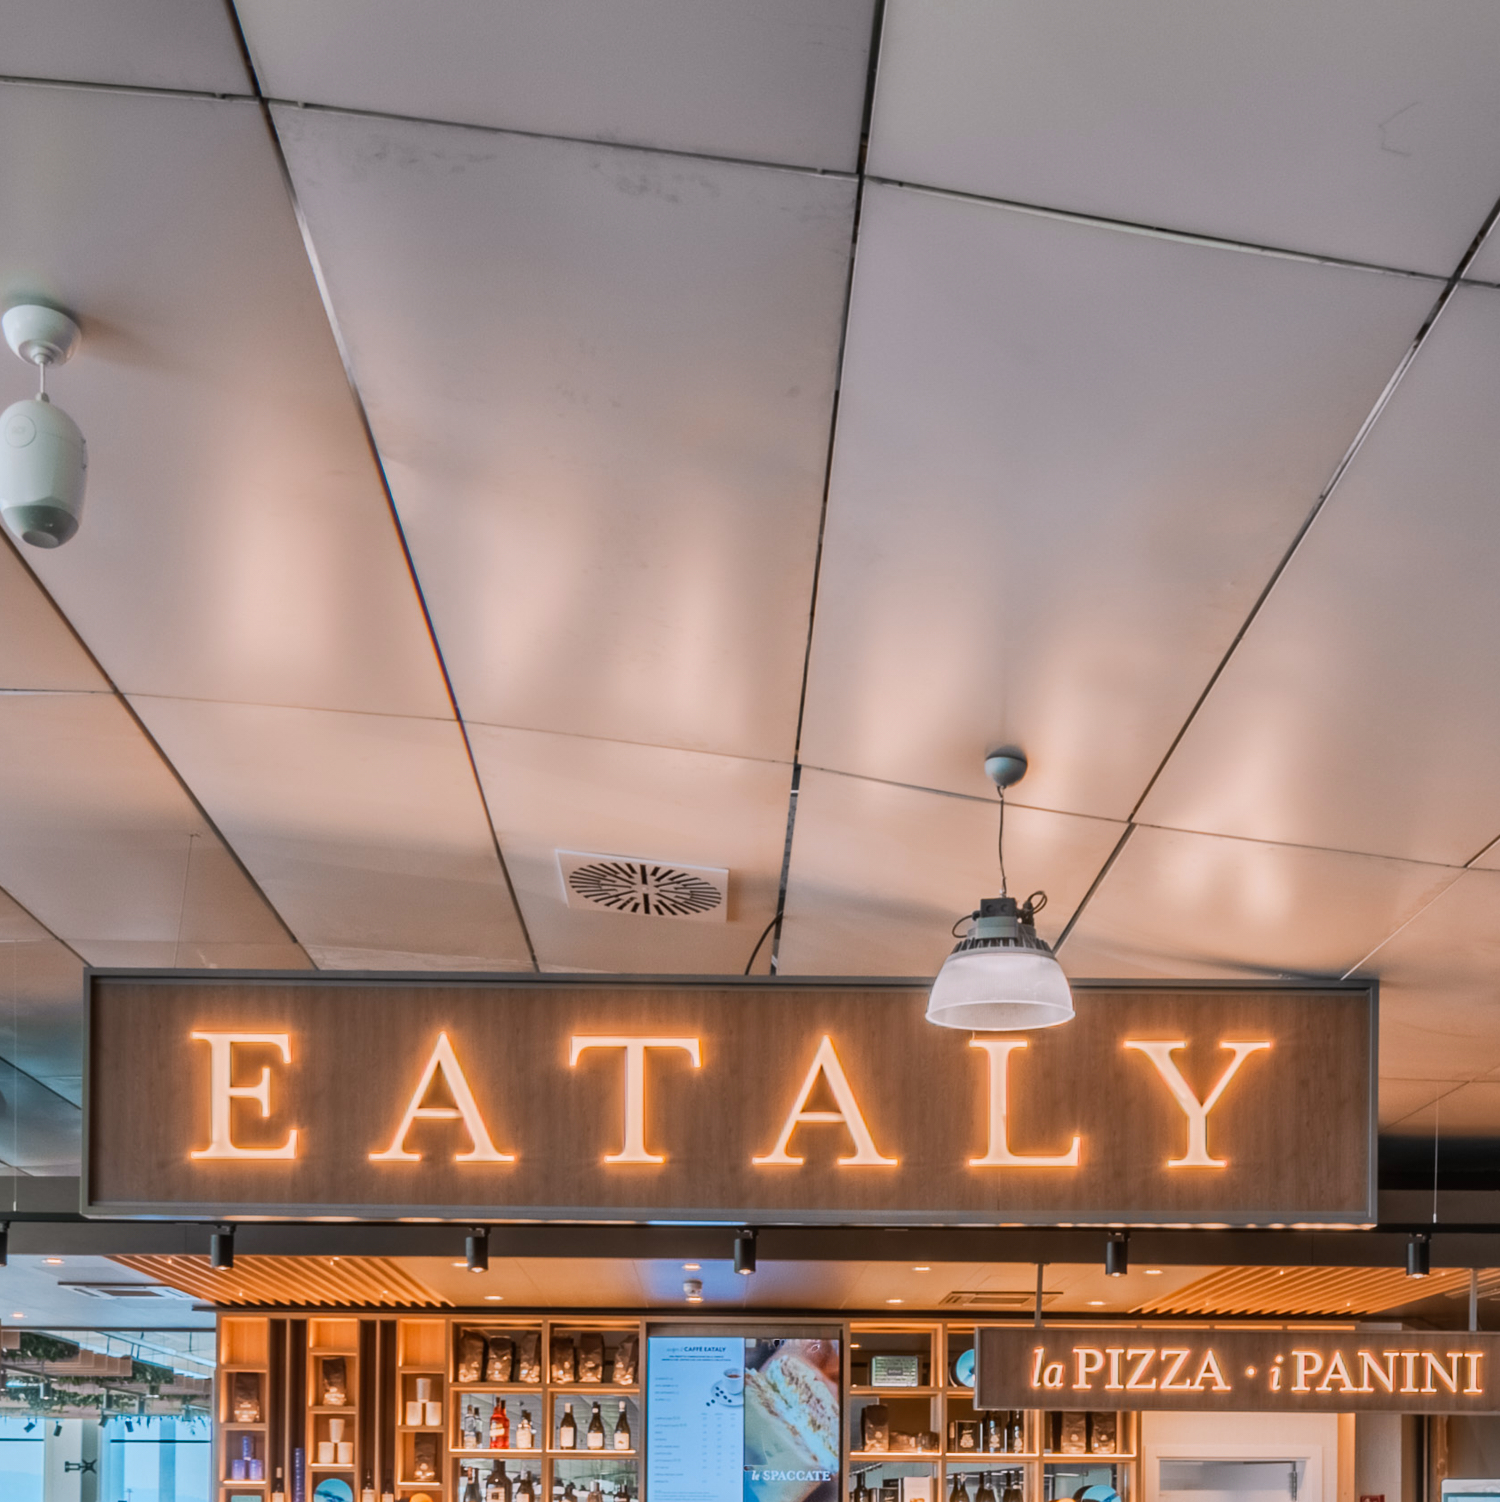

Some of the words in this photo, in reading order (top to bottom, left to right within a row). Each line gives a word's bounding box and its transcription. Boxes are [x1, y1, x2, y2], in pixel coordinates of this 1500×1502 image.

[190, 1029, 1271, 1168] EATALY
[1031, 1347, 1064, 1389] la
[1072, 1347, 1231, 1391] PIZZA
[1270, 1355, 1284, 1390] i
[1291, 1350, 1484, 1394] PANINI
[762, 1470, 831, 1482] SPACCATE
